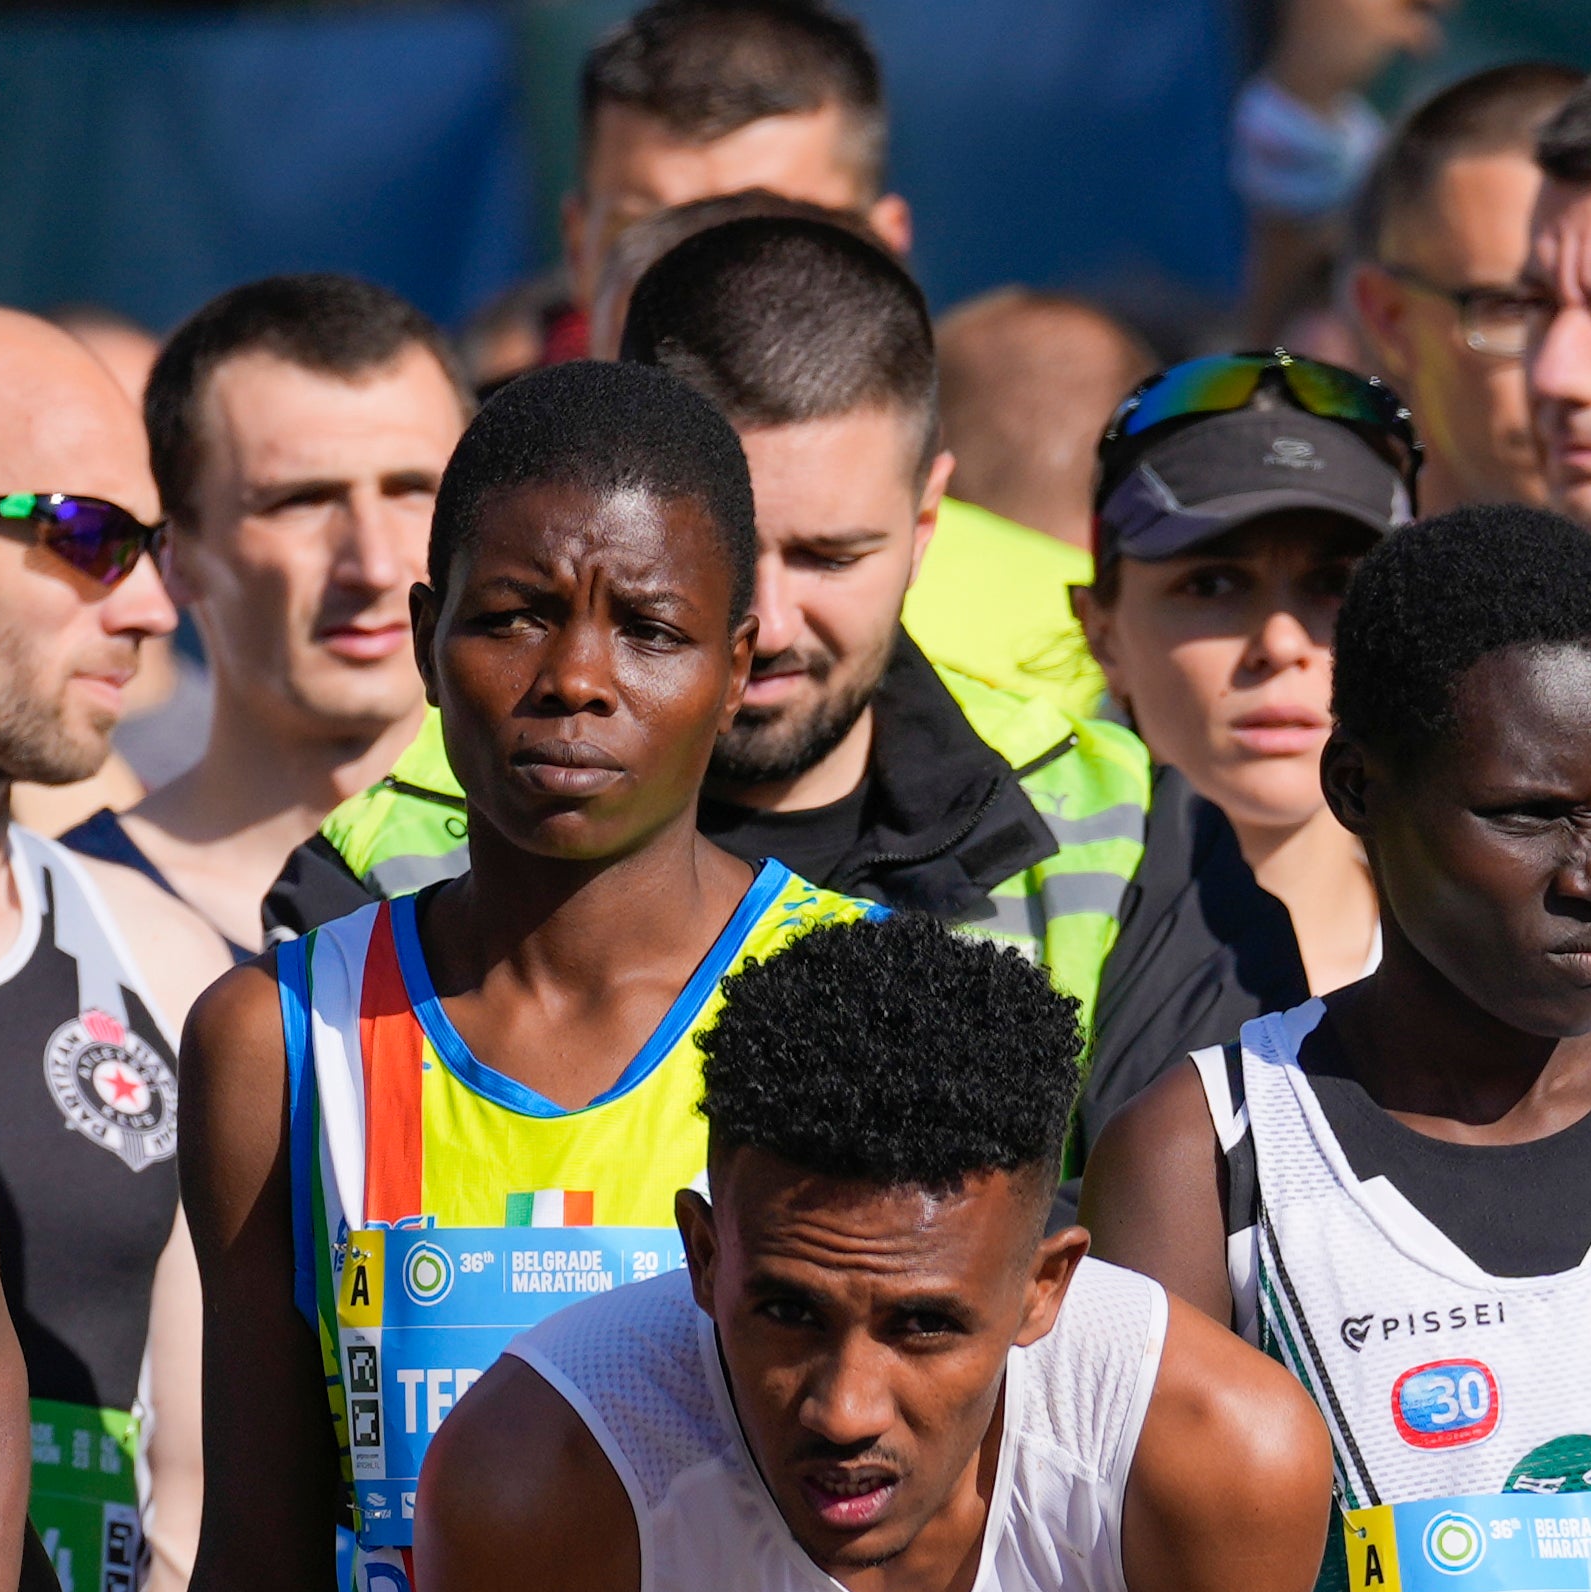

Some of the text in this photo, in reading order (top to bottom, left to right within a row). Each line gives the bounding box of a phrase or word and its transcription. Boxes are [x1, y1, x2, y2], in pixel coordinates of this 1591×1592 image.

[459, 1251, 659, 1272] 36th BELGRADE 20
[350, 1265, 370, 1306] A
[512, 1271, 613, 1293] MARATHON
[1382, 1302, 1504, 1340] PISSEI
[1428, 1371, 1489, 1424] 30
[1489, 1517, 1521, 1539] 36th
[1364, 1544, 1384, 1587] A
